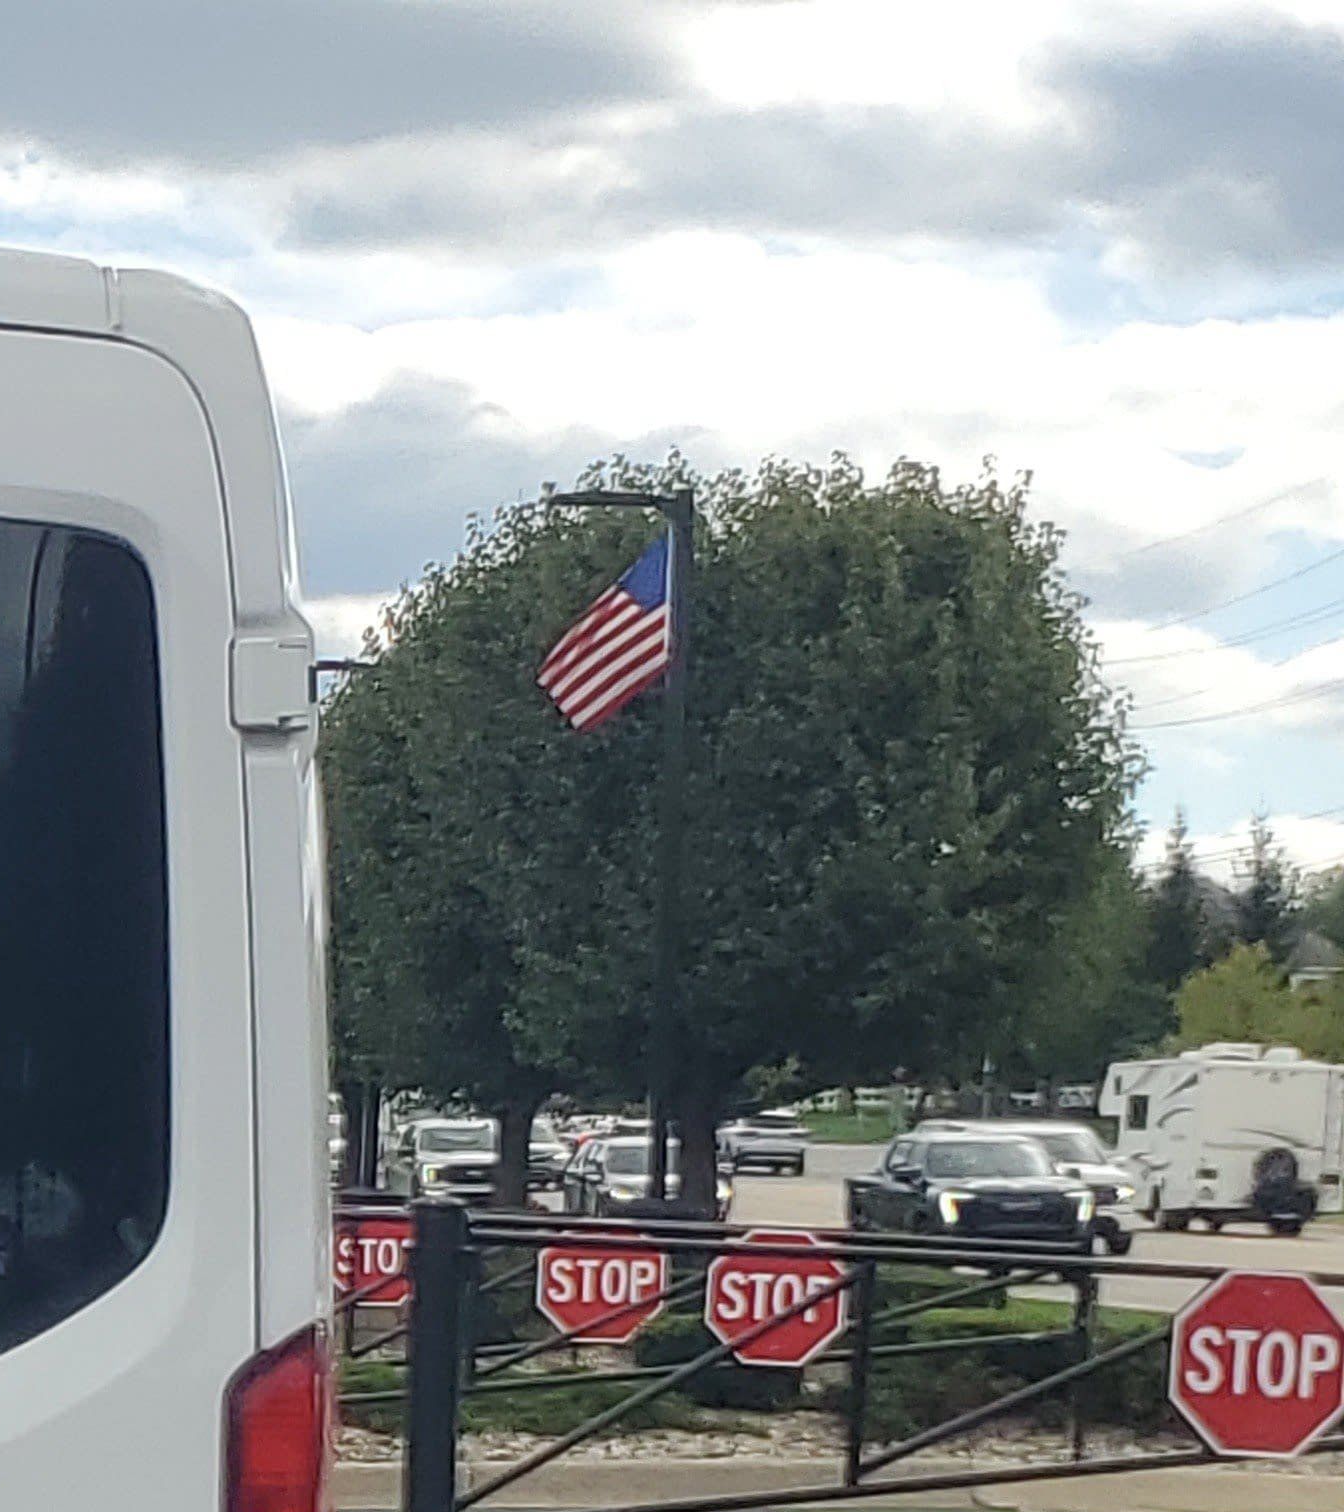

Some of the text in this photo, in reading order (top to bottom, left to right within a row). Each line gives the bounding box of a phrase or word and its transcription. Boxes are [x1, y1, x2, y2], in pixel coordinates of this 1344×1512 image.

[547, 1258, 657, 1304] STOP
[717, 1271, 834, 1323] STOP
[1184, 1325, 1340, 1399] STOP
